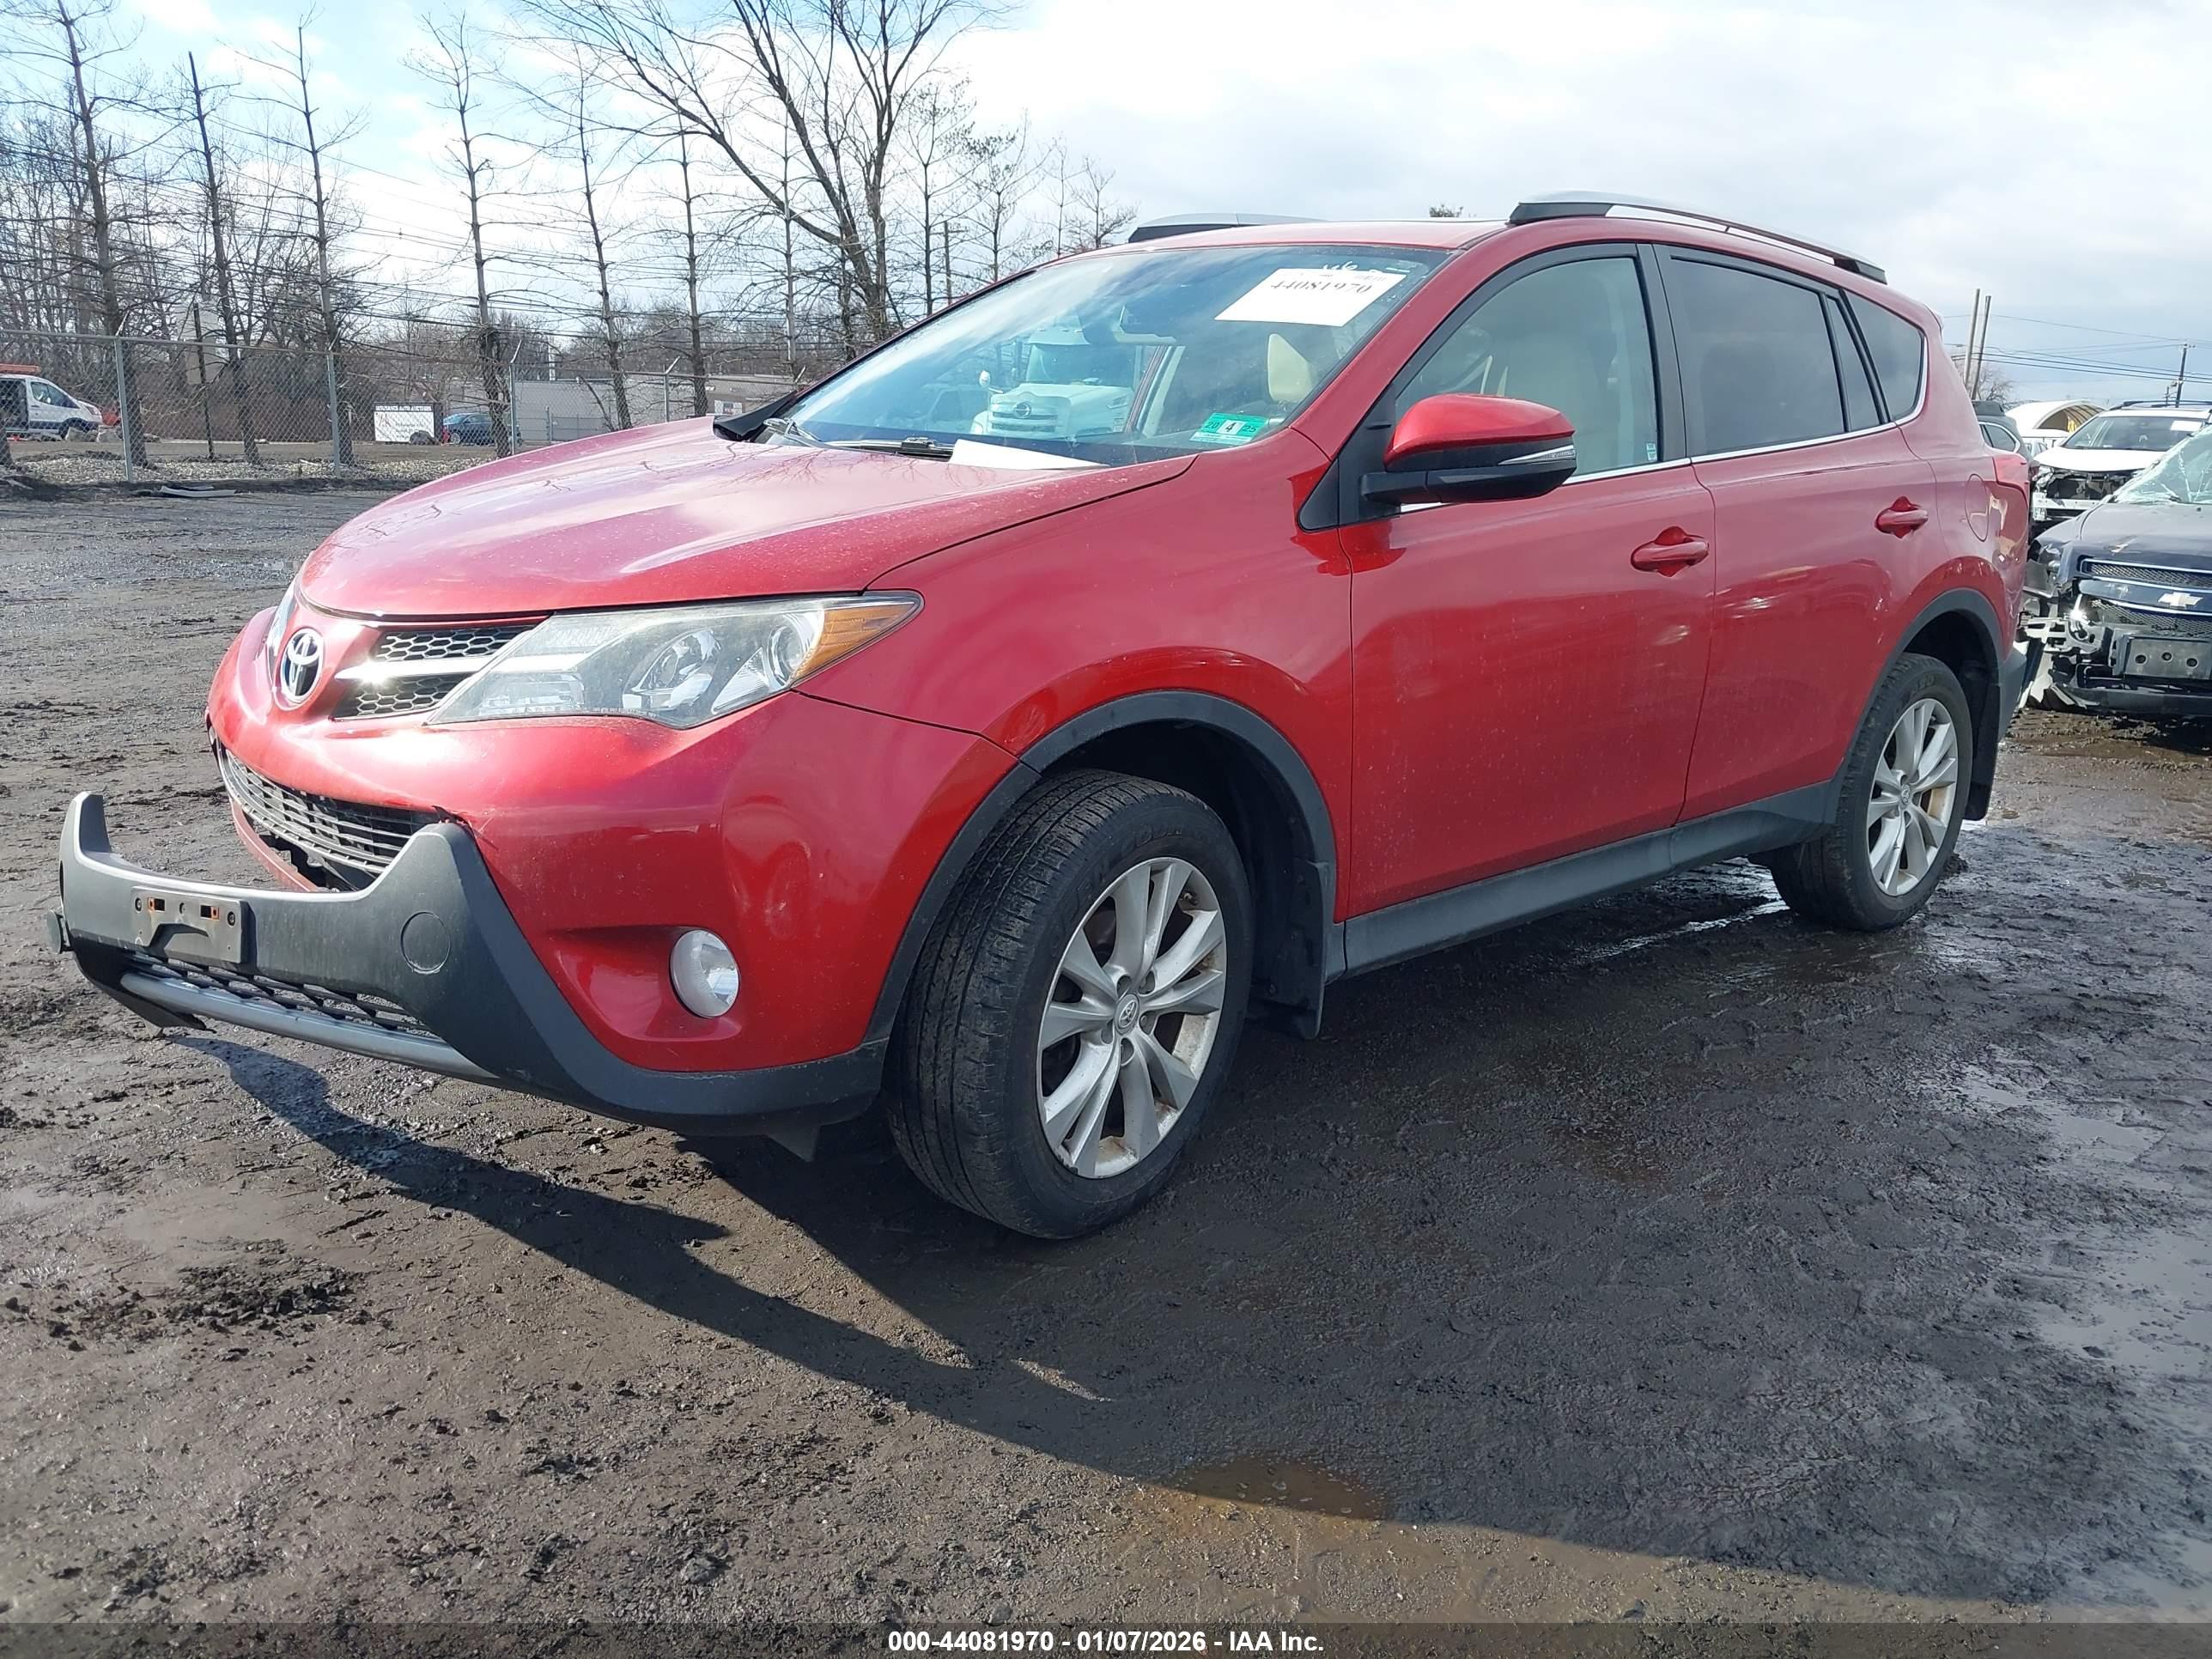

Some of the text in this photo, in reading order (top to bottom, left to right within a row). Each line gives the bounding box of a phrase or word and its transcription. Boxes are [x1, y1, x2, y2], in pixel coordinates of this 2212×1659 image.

[1271, 280, 1372, 293] 44081970
[1205, 421, 1219, 429] 20
[1225, 422, 1237, 433] 4
